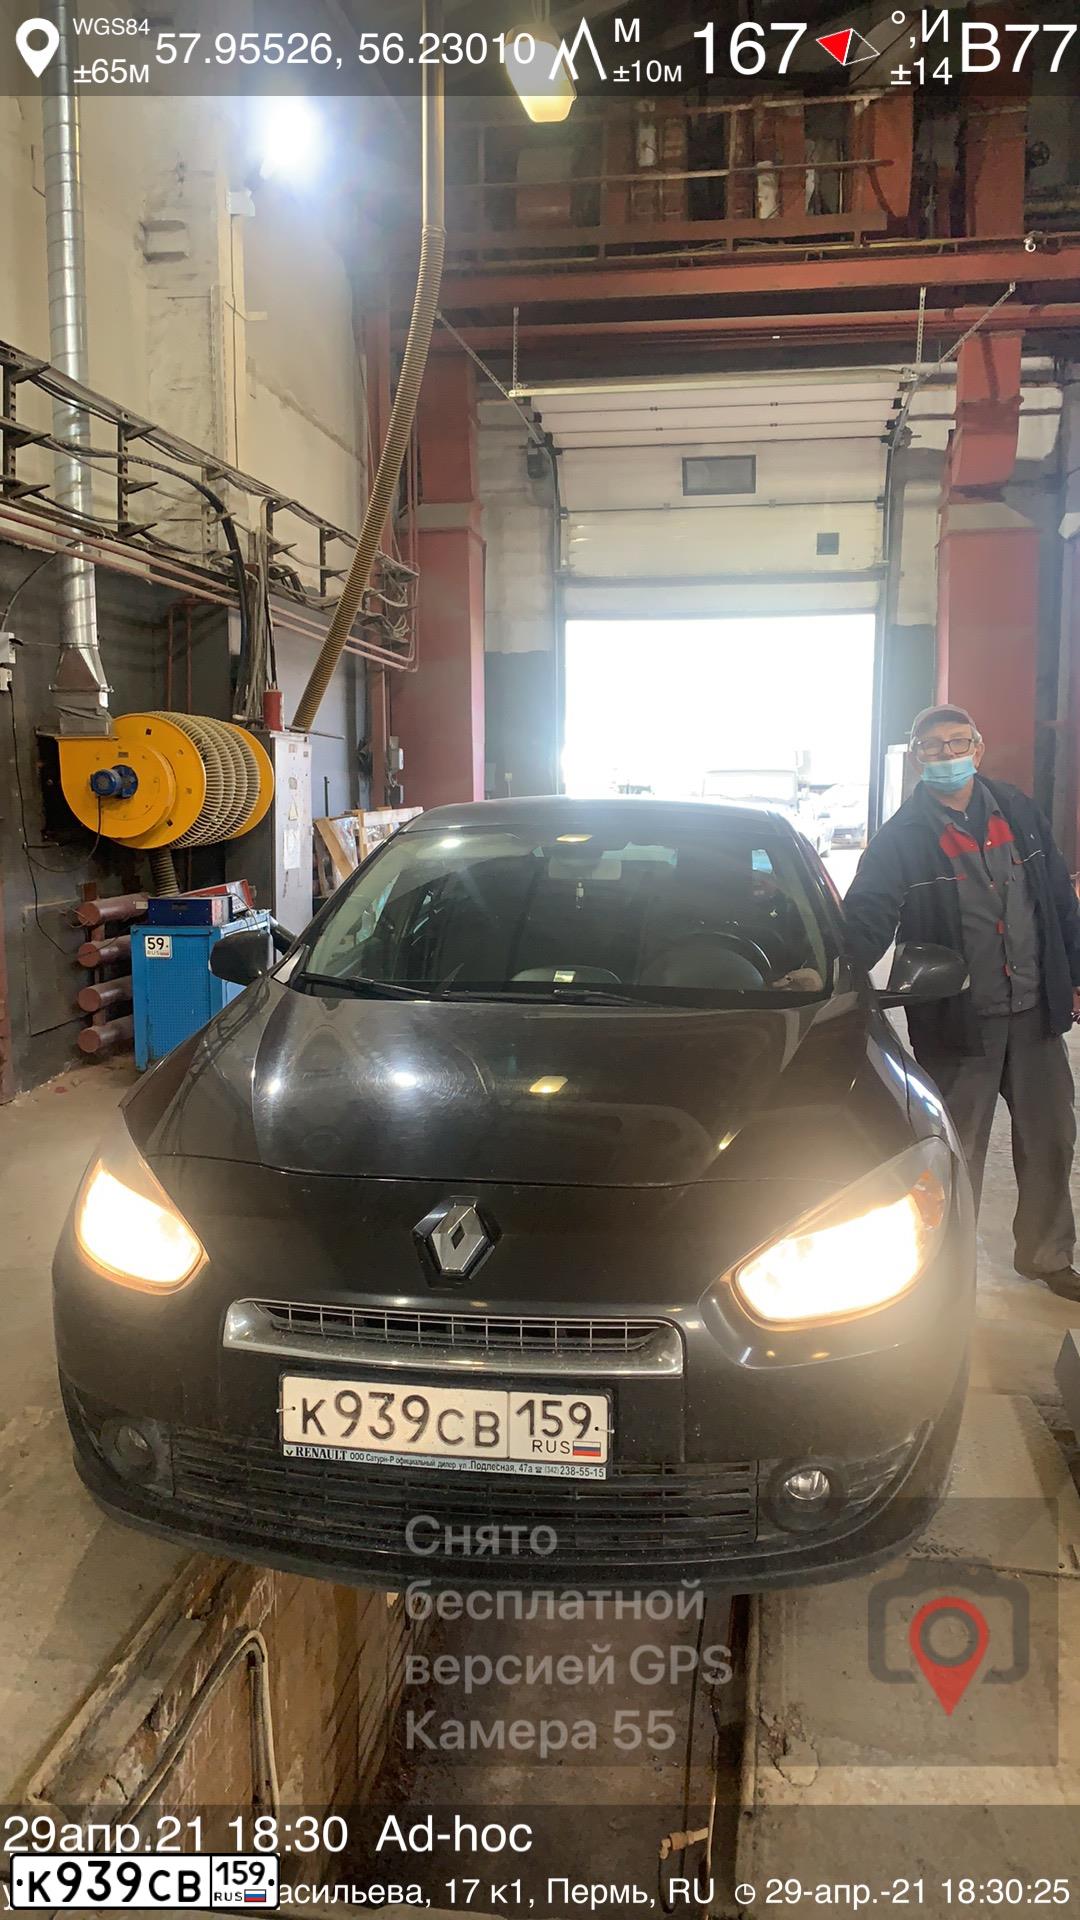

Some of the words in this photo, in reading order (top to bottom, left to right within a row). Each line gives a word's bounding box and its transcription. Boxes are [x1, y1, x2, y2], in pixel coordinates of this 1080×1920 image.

[515, 1399, 592, 1439] 159
[295, 1446, 348, 1461] RENAULT
[560, 1464, 605, 1478] 238-55-15
[532, 1439, 571, 1455] RUS
